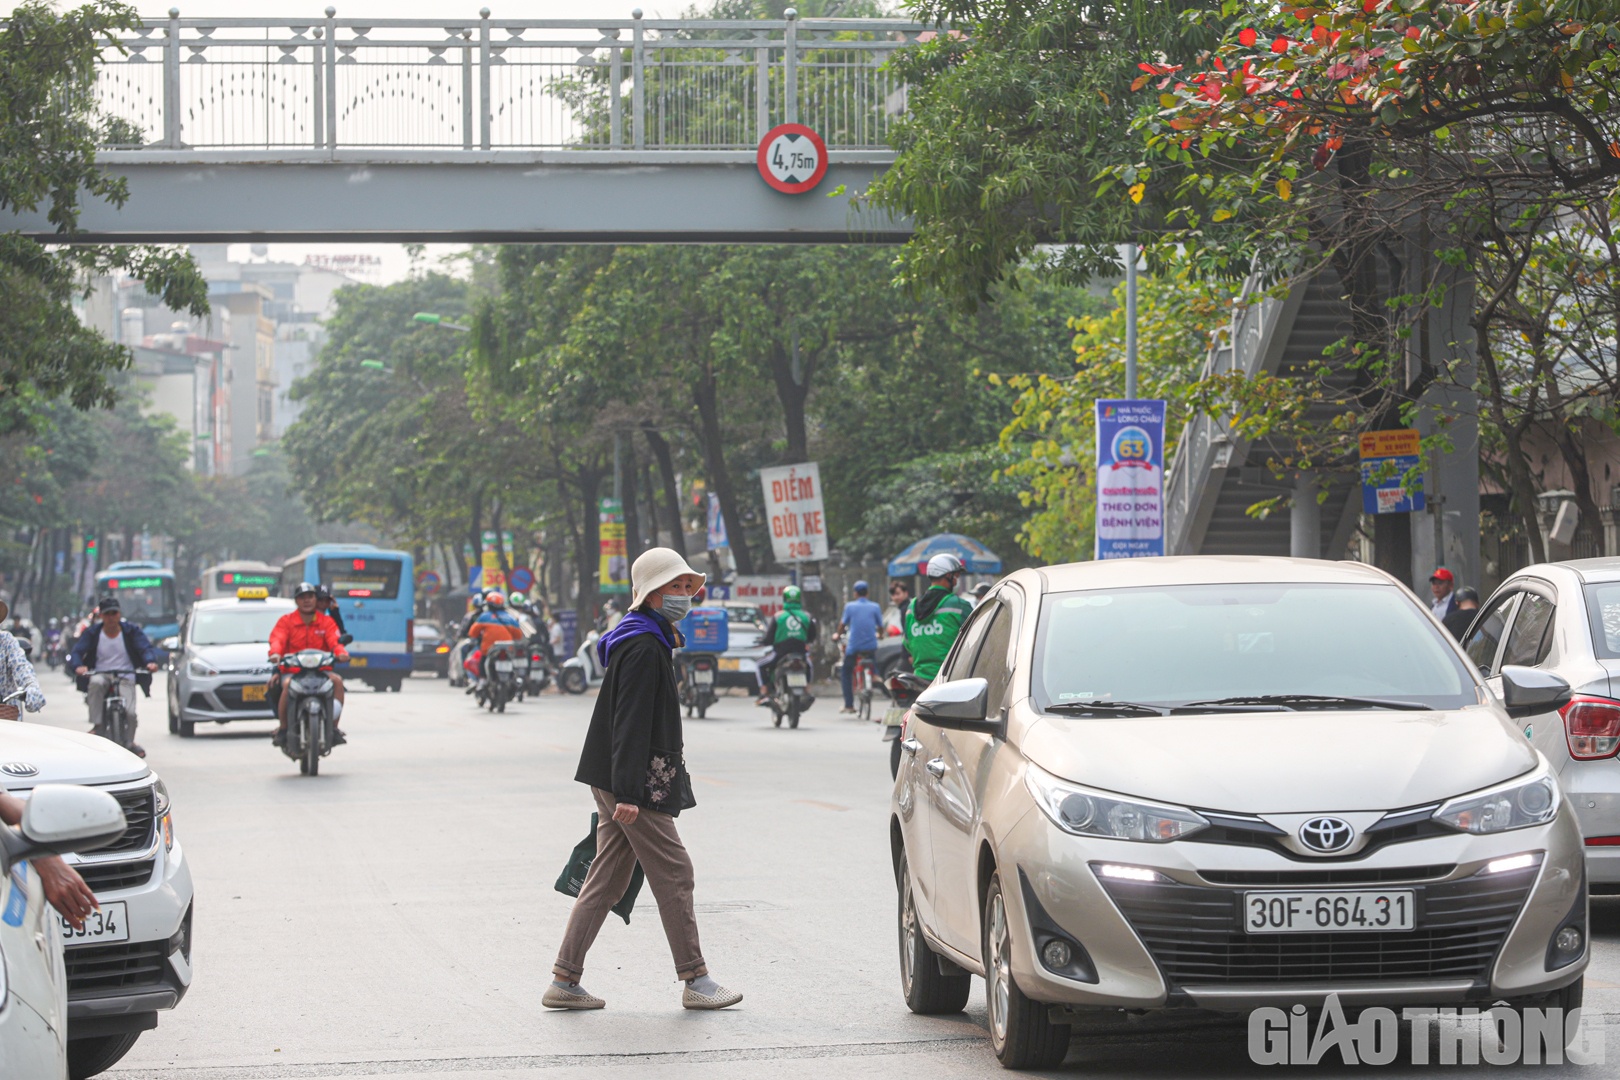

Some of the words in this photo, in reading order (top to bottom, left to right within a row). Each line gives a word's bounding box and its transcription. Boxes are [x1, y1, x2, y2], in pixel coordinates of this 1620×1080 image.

[772, 143, 815, 172] 4,75m
[1119, 440, 1145, 458] 63
[771, 468, 815, 503] ĐIỂM
[1102, 502, 1132, 512] THEO
[772, 507, 799, 538] GỬI
[802, 511, 824, 535] XE
[1102, 516, 1132, 528] BỆNH
[1135, 516, 1159, 529] VIỆN
[911, 619, 944, 637] Grab
[9, 763, 36, 773] KIA
[1250, 896, 1405, 928] 30F-664.31
